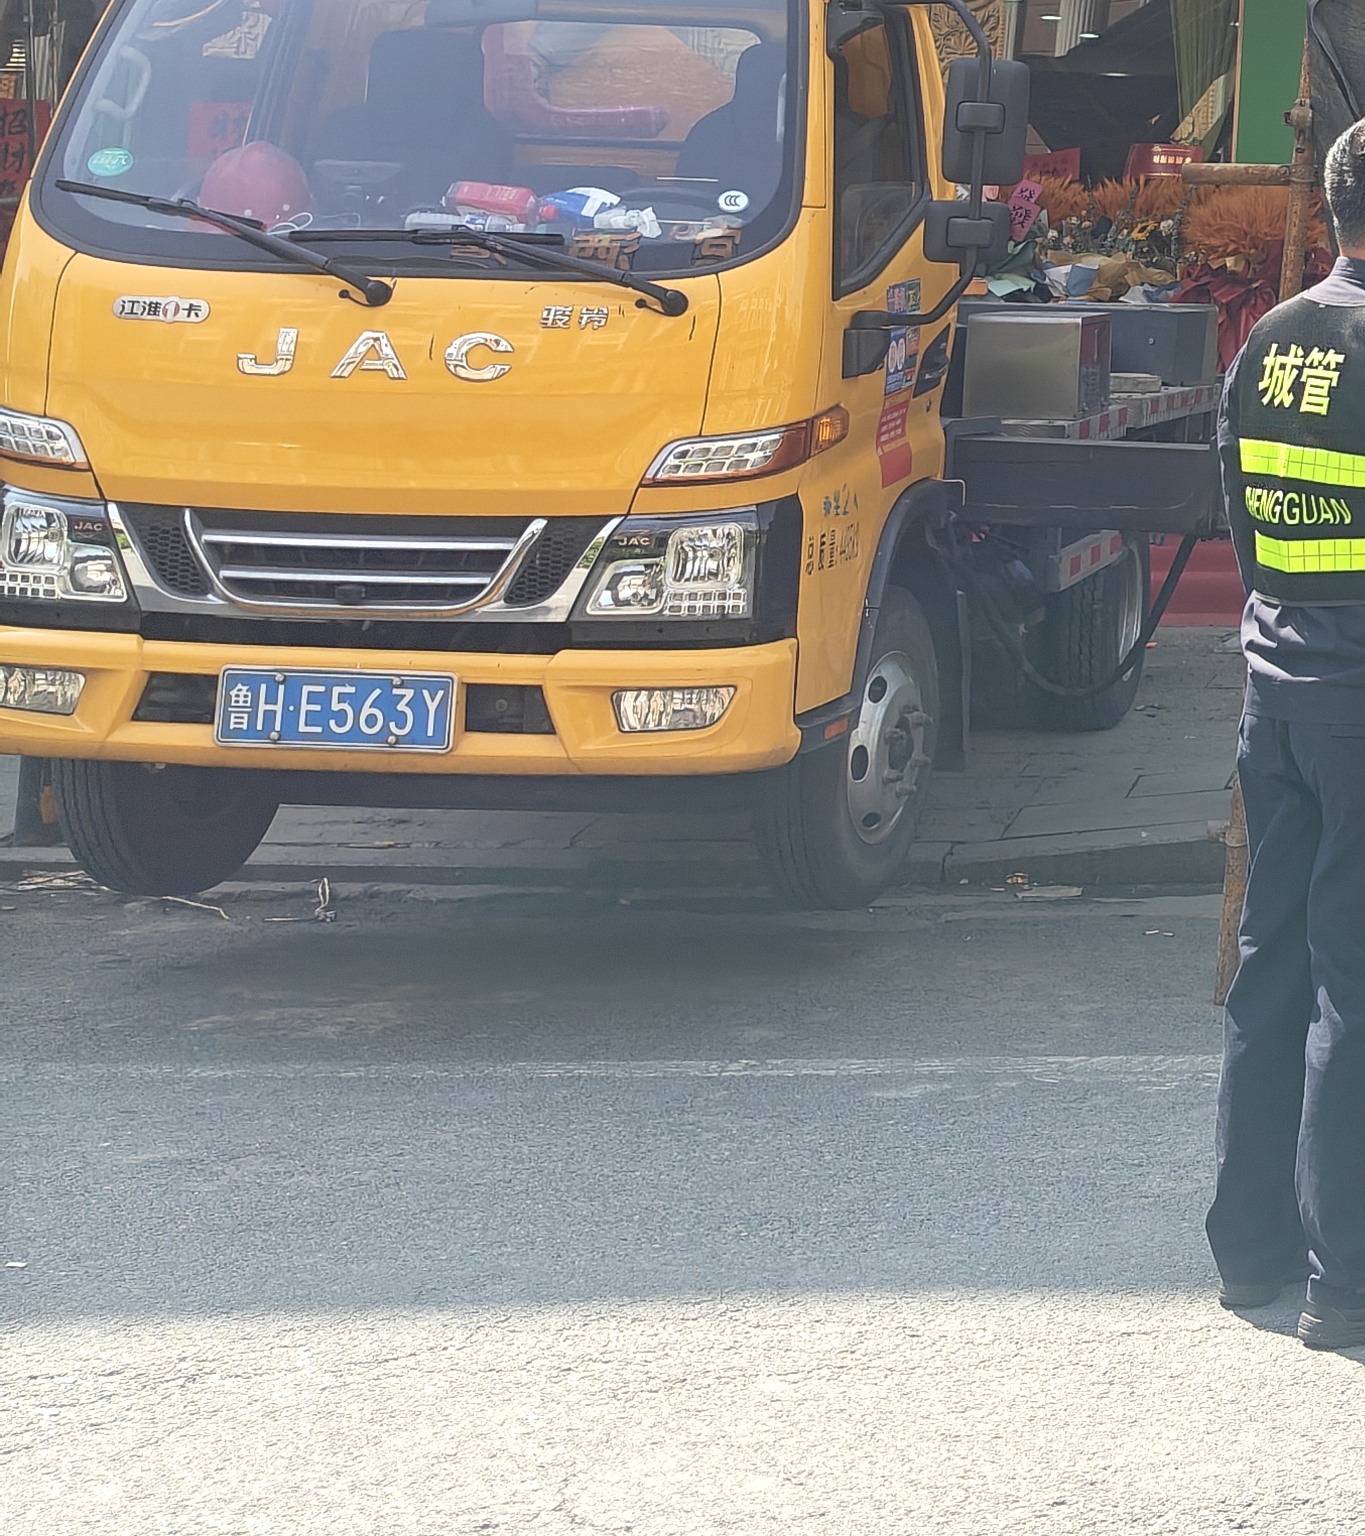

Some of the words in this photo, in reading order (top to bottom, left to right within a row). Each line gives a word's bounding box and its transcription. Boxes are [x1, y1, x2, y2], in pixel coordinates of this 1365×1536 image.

[237, 327, 514, 382] JAC
[1258, 342, 1346, 416] 城管
[74, 521, 103, 532] JAC
[618, 536, 651, 546] JAC
[228, 682, 445, 737] 鲁H·E563Y
